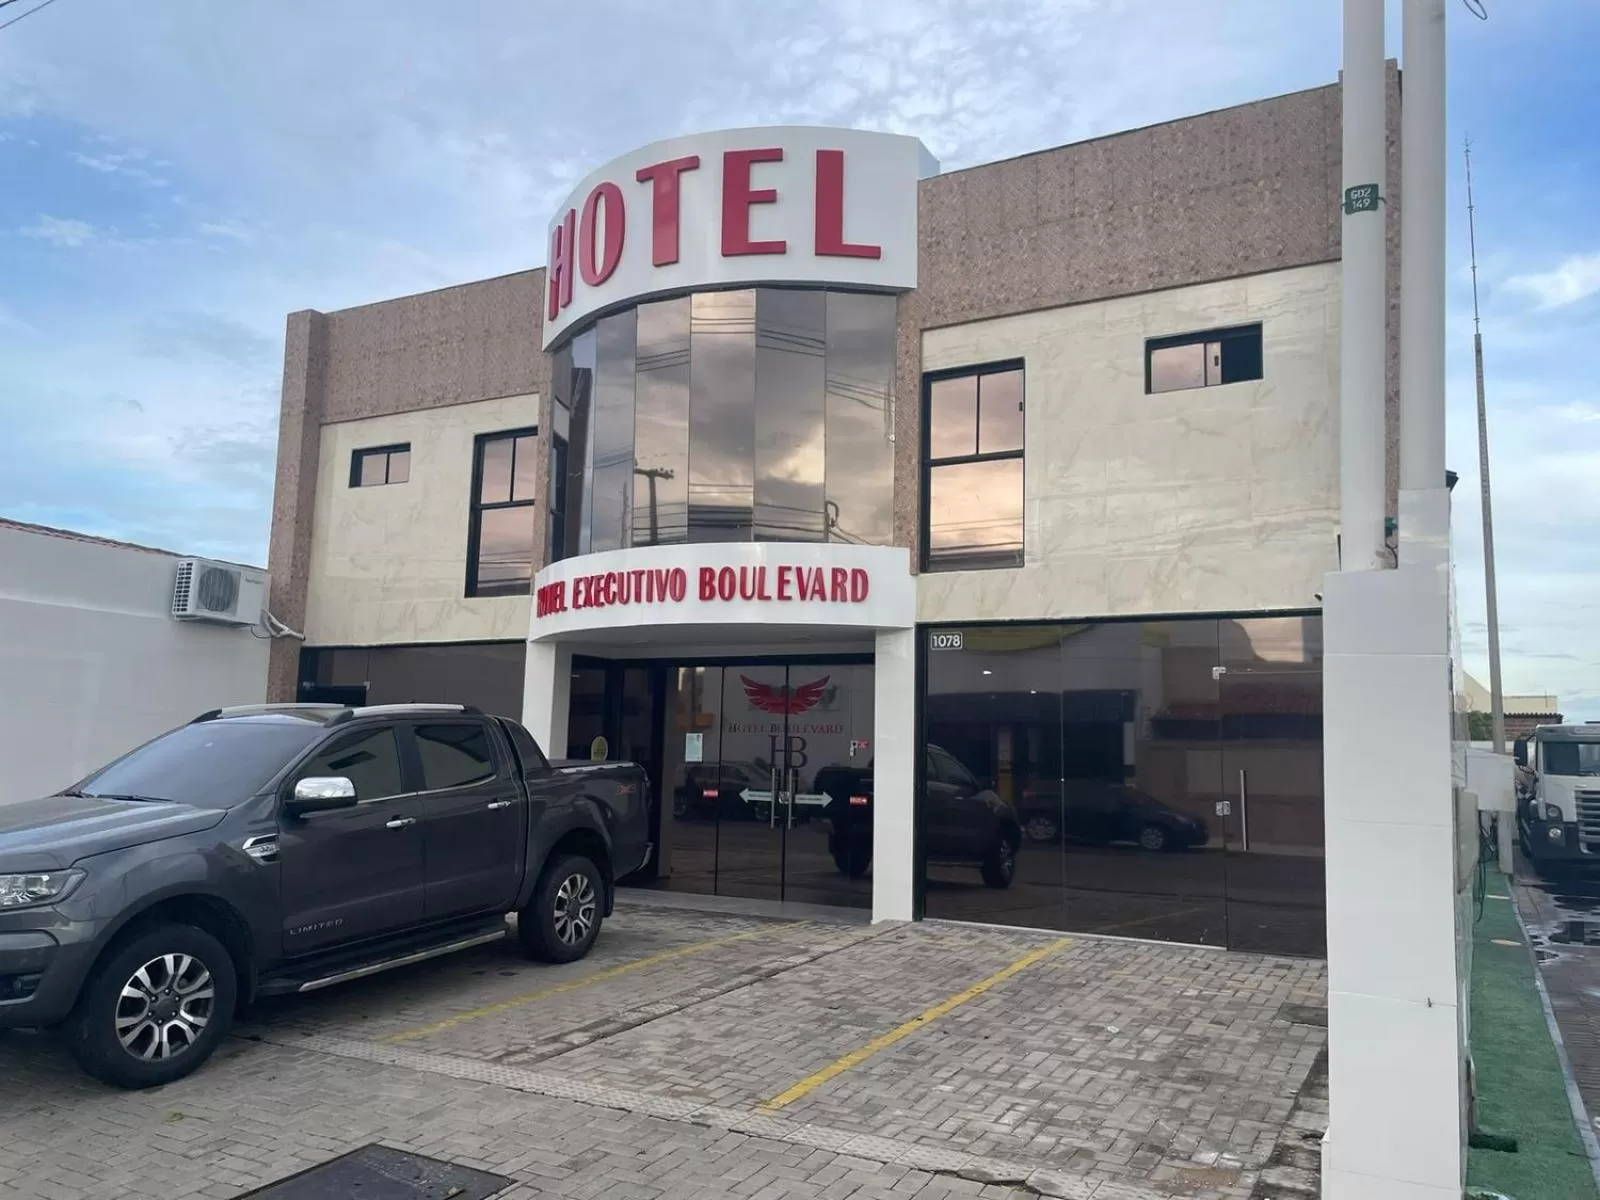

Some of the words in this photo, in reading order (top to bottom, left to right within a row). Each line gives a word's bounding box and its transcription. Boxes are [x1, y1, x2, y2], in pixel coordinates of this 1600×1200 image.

[1352, 198, 1371, 209] 149
[548, 148, 881, 322] HOTEL
[572, 567, 687, 609] EXECUTIVO
[699, 565, 869, 603] BOULEVARD
[932, 634, 961, 647] 1078
[289, 918, 344, 935] LIMITED
